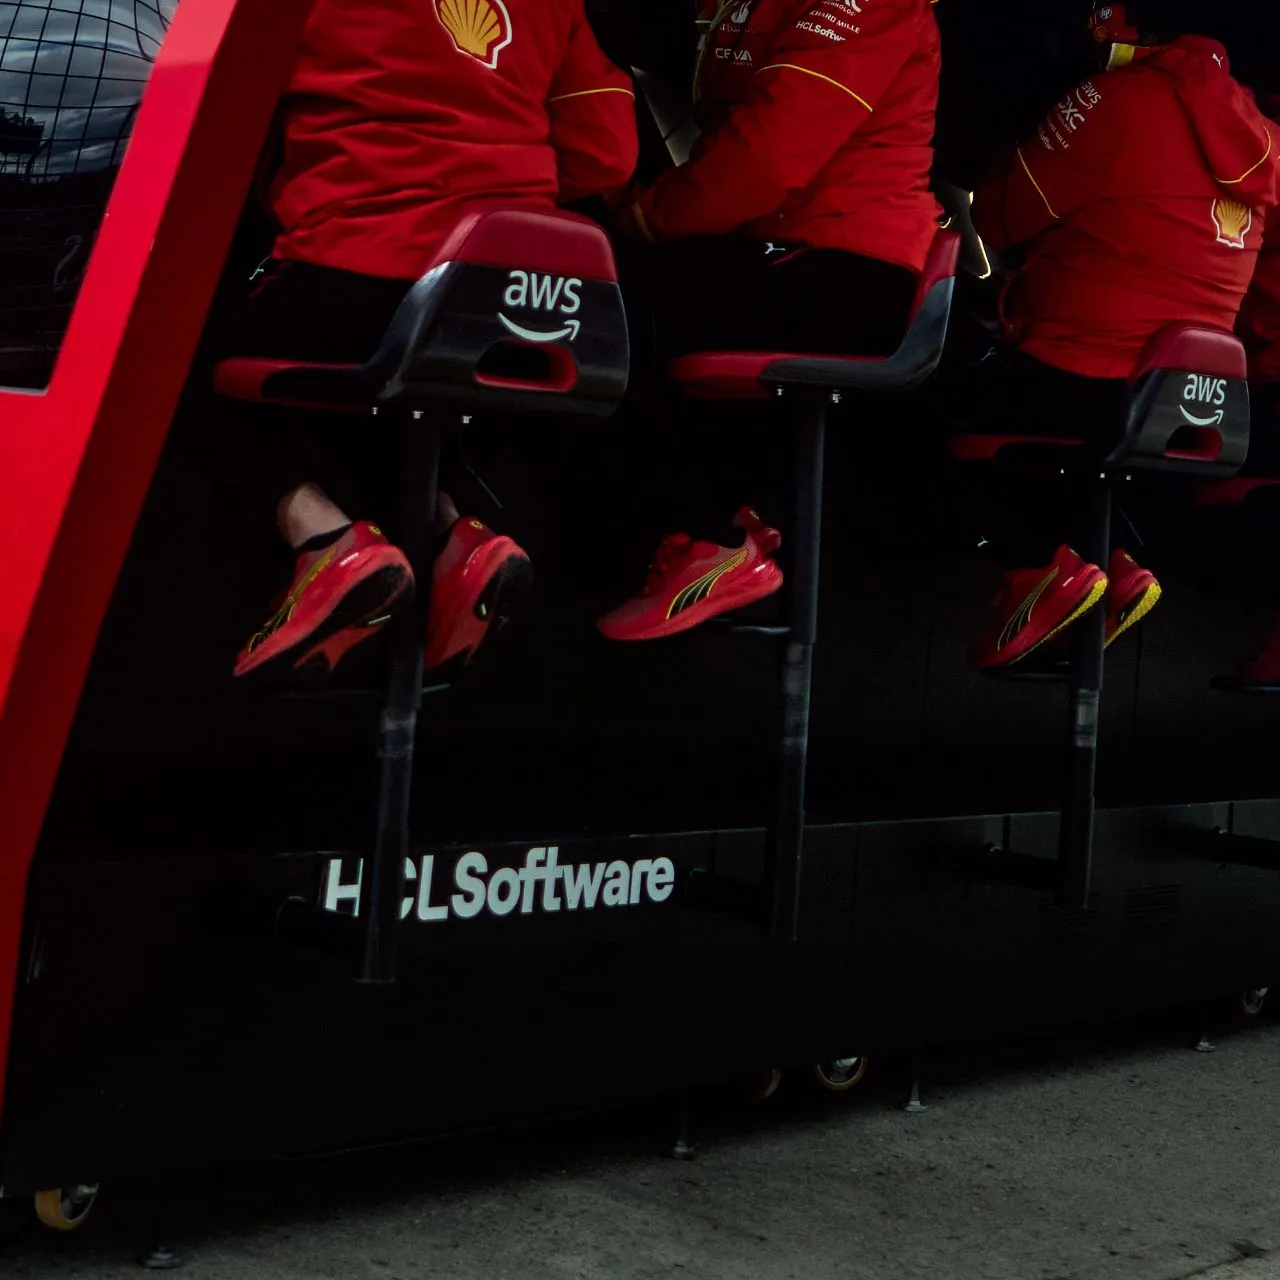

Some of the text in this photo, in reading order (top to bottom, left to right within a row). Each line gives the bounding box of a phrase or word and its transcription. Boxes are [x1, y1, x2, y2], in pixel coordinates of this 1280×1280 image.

[836, 20, 861, 34] MILLE
[715, 47, 752, 61] CEVA
[503, 269, 583, 313] aws
[1183, 373, 1227, 405] aws
